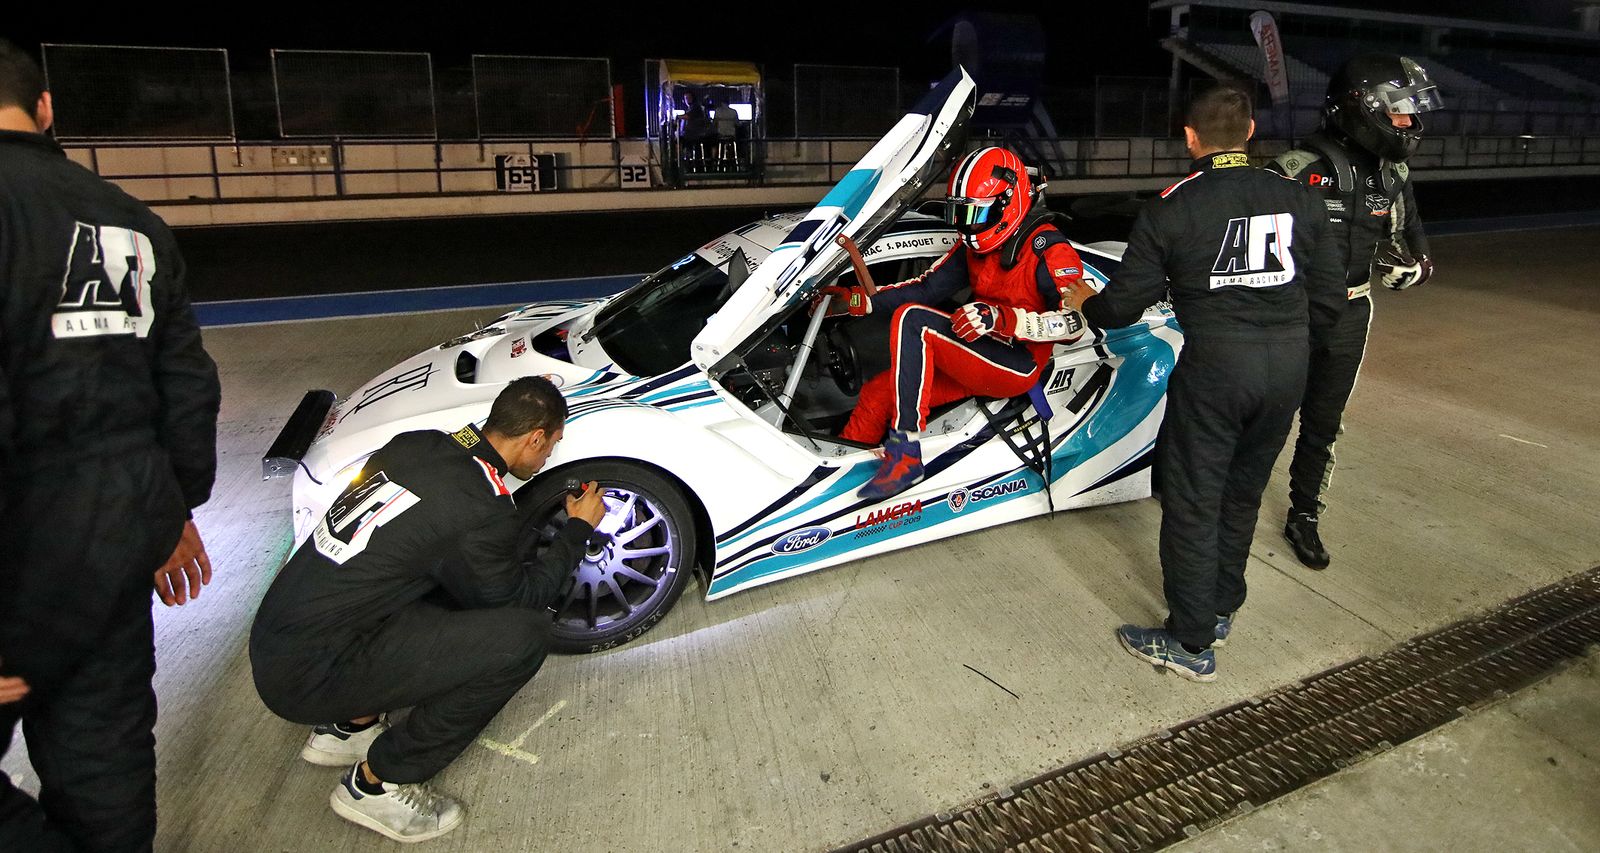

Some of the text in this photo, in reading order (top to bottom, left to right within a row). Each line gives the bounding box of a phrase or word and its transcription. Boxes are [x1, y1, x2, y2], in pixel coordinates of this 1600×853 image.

[622, 167, 647, 182] 32
[895, 238, 934, 250] PASQUET
[941, 237, 951, 245] G.
[971, 479, 1028, 502] SCANIA
[855, 499, 922, 529] LAMERA
[888, 515, 922, 530] CUP 2019
[784, 530, 821, 551] Ford
